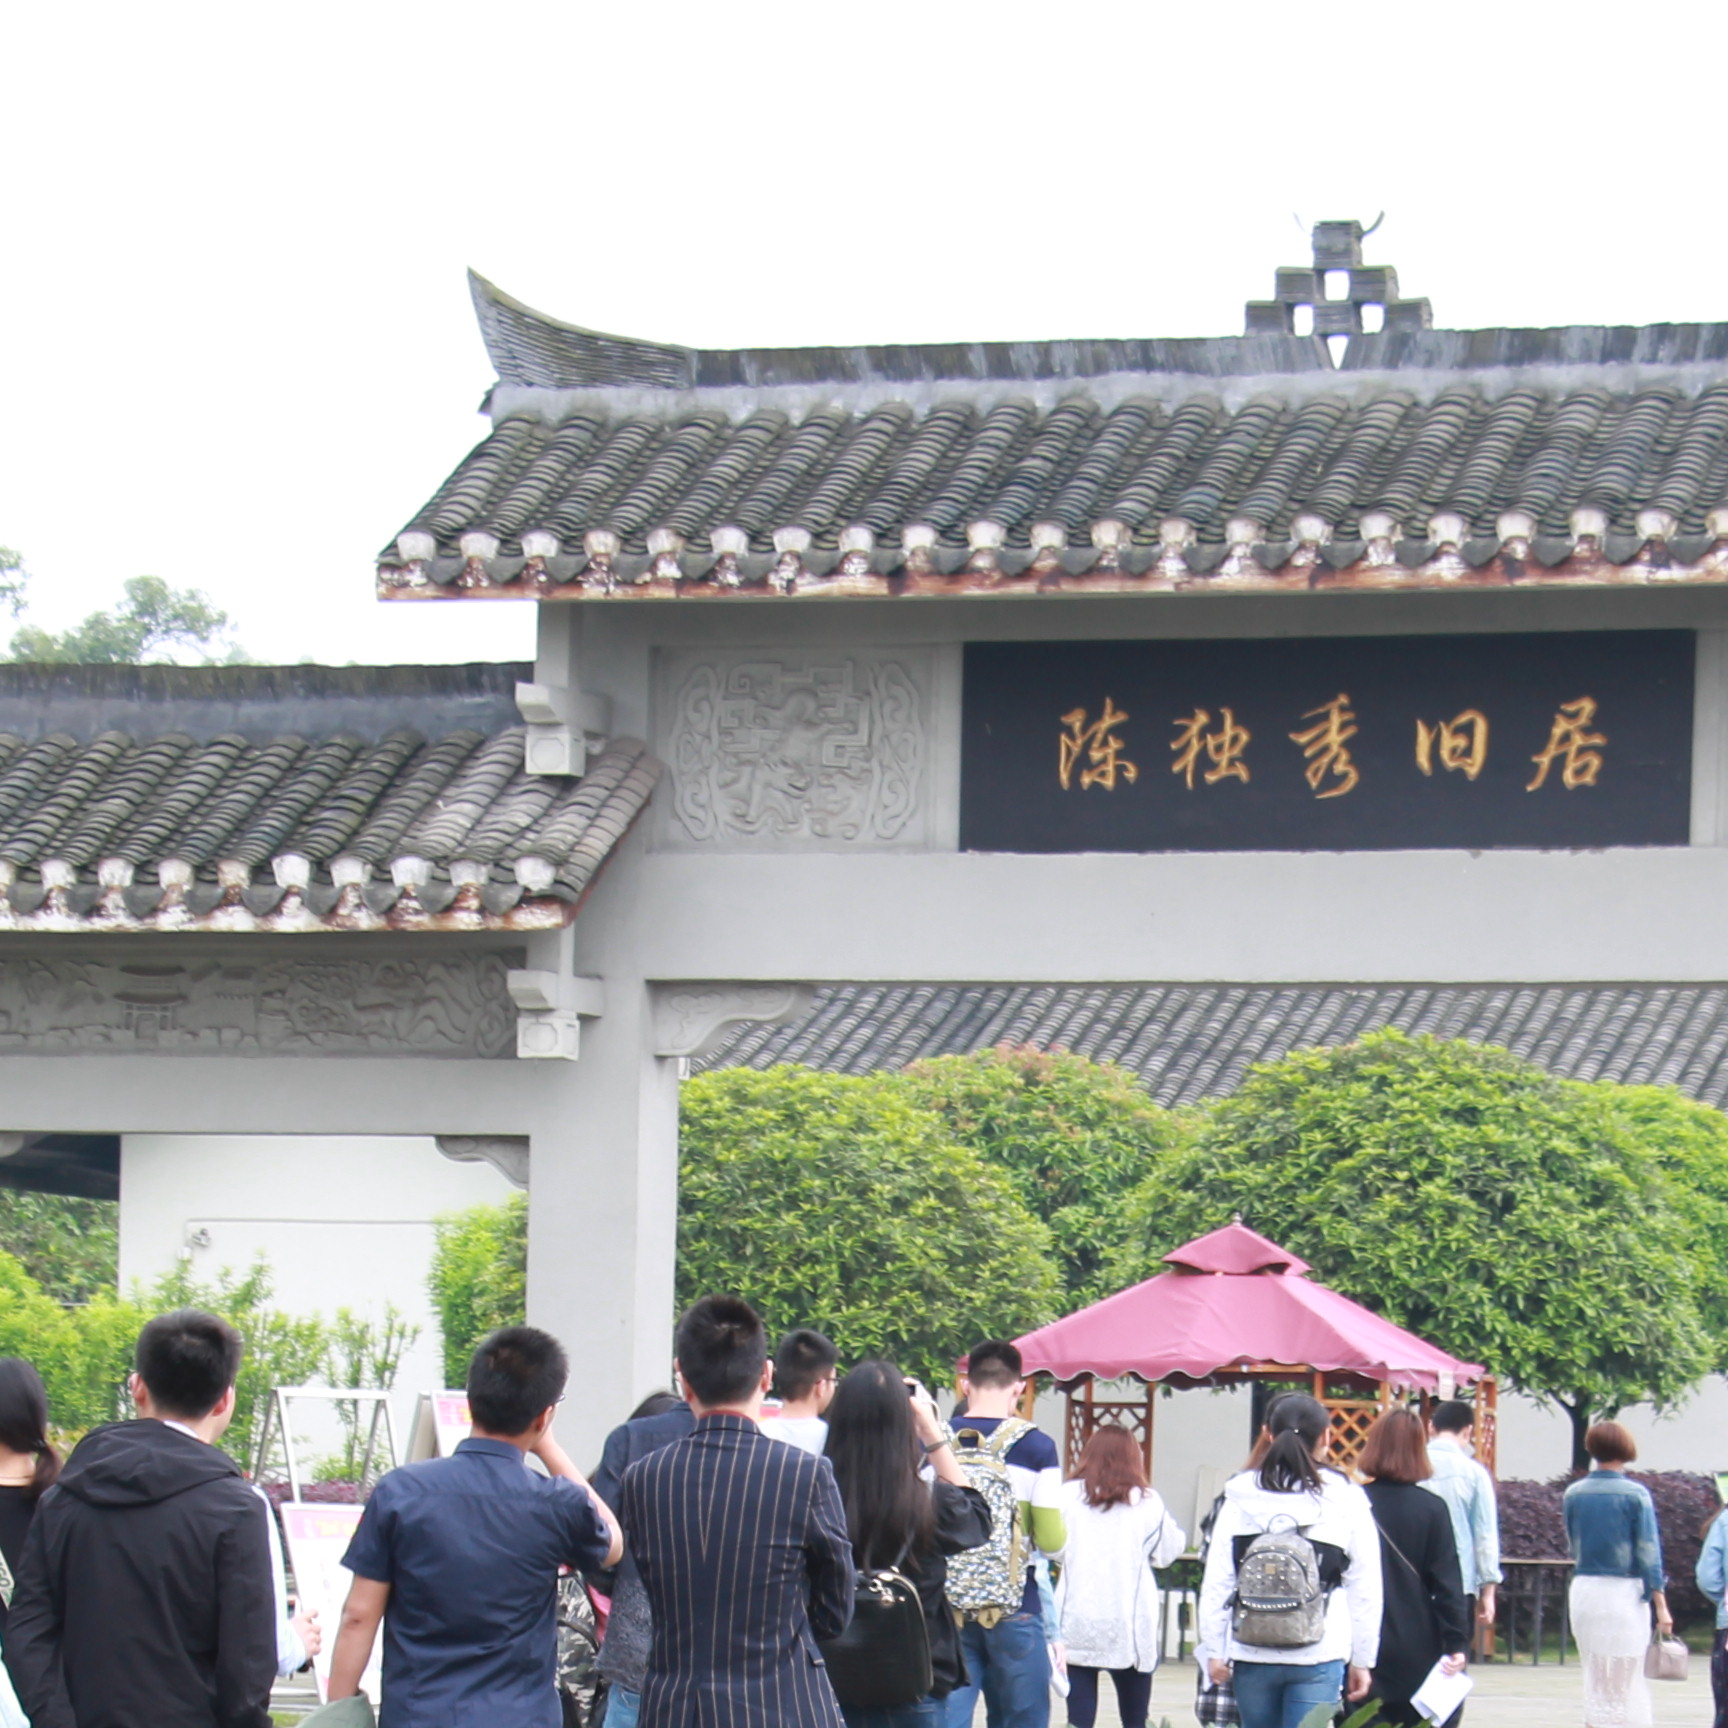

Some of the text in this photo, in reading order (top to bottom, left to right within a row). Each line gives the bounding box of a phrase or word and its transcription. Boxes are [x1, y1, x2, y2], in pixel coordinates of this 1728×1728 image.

[1058, 693, 1609, 799] 陈独秀旧居
